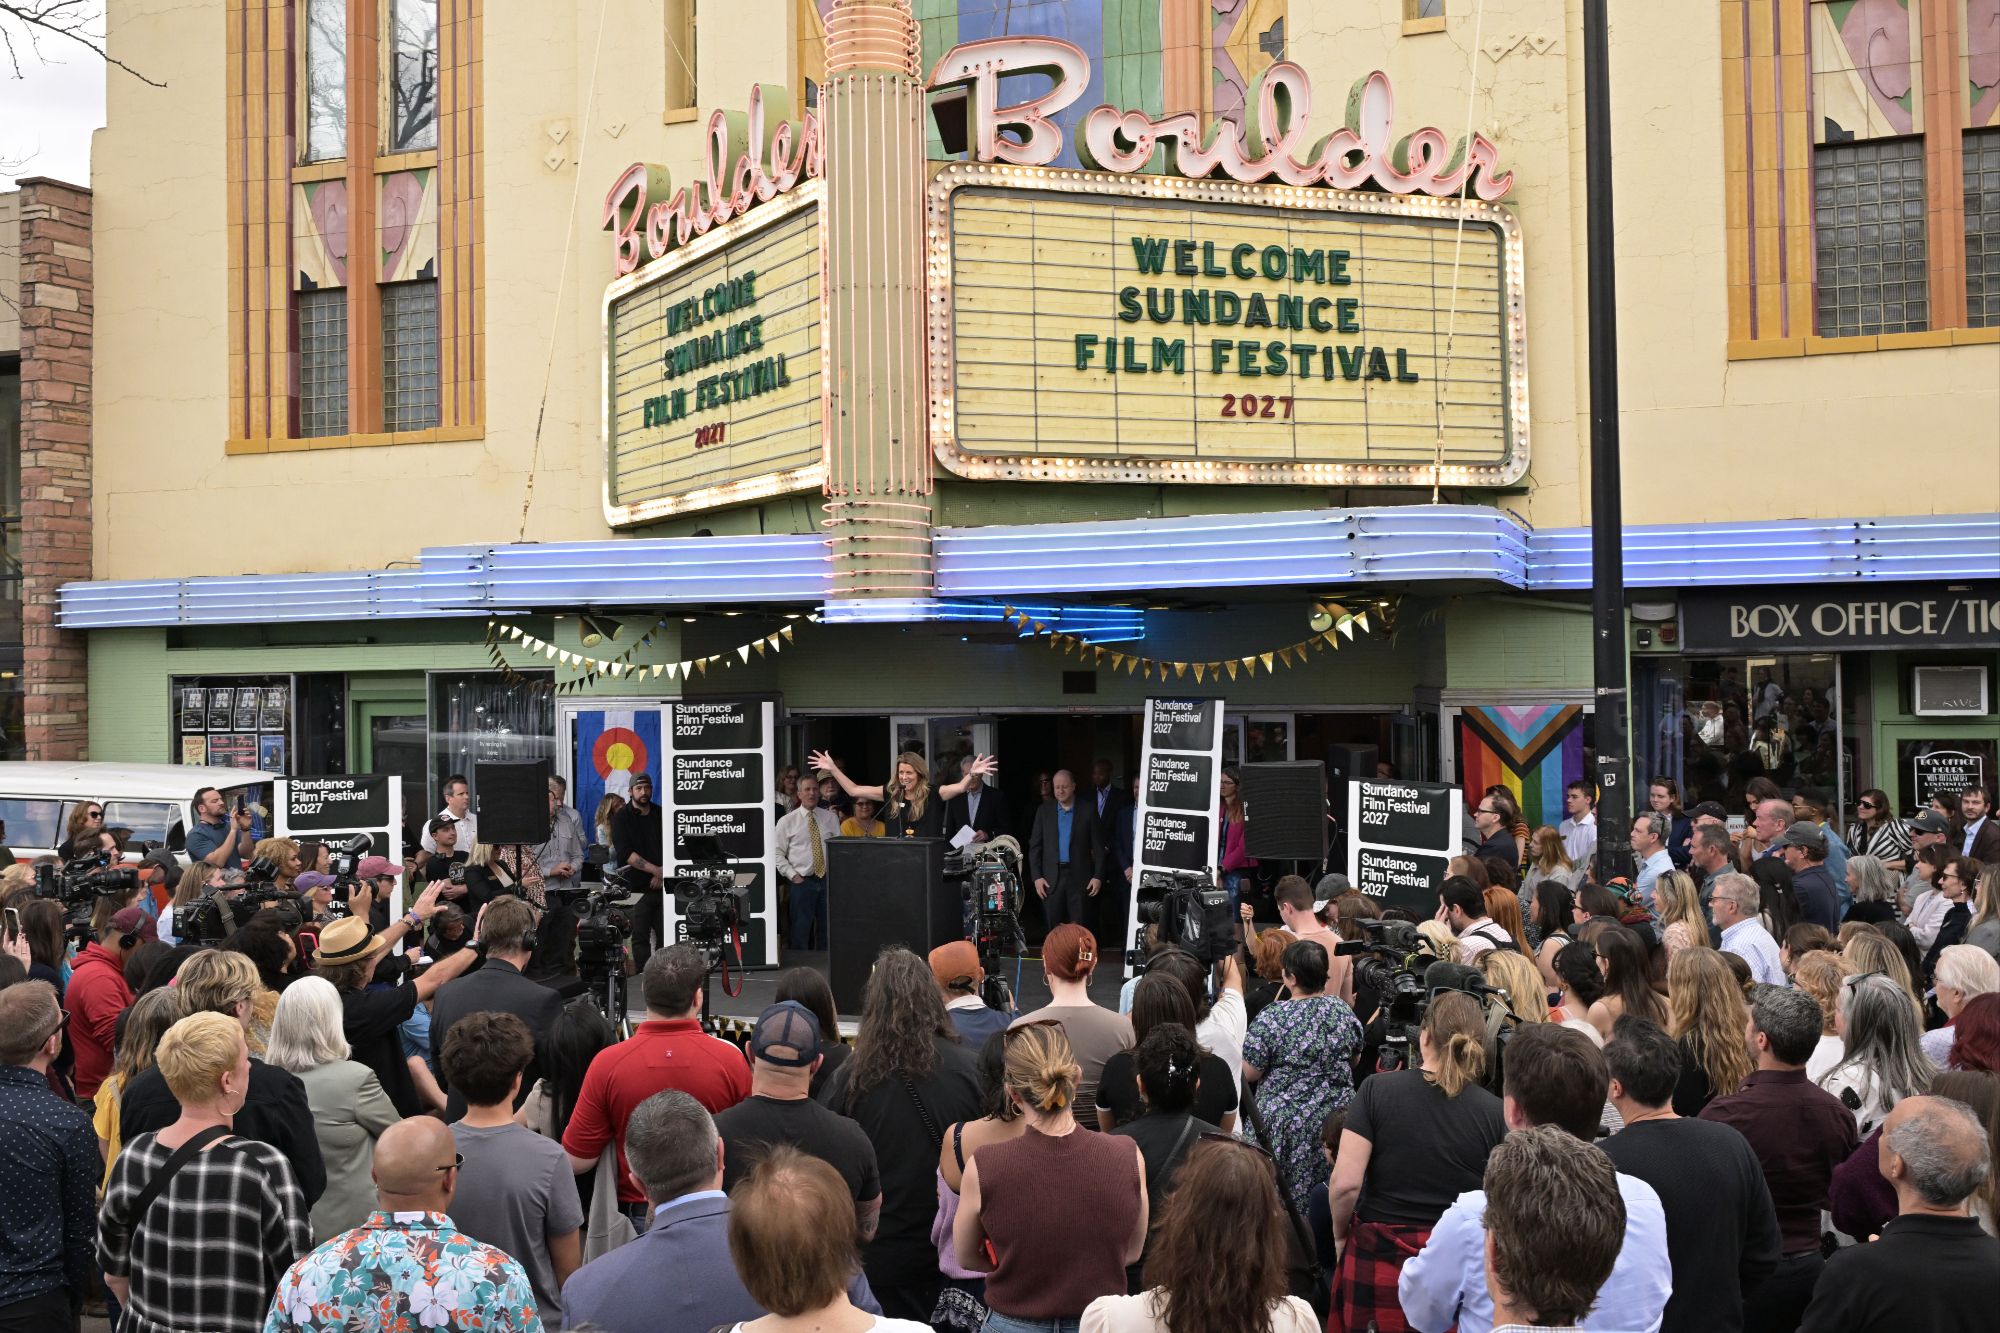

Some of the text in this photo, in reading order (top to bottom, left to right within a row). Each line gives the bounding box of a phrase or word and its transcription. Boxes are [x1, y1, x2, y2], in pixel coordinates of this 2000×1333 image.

[926, 35, 1514, 199] Boulder
[603, 83, 819, 278] Boulder
[1132, 236, 1351, 286] WELCOME
[666, 270, 757, 336] WELCOME
[1119, 287, 1359, 333] SUNDANCE
[664, 315, 764, 380] SUNDANCE
[1075, 335, 1419, 383] FILM FESTIVAL
[643, 353, 790, 428] FILM FESTIVAL
[1221, 393, 1295, 419] 2027
[694, 421, 726, 448] 2027
[1731, 604, 1801, 637] BOX
[676, 704, 731, 713] Sundance
[1155, 700, 1193, 710] Sundance
[676, 714, 743, 724] Film Festival
[1154, 711, 1201, 722] Film Festival
[676, 726, 704, 735] 2027
[1153, 723, 1172, 733] 2027
[677, 758, 732, 768] Sundance
[1152, 757, 1189, 769] Sundance
[677, 768, 744, 779] Film Festival
[1151, 769, 1198, 782] Film Festival
[291, 779, 354, 790] Sundance
[677, 781, 704, 790] 2027
[1150, 781, 1169, 791] 2027
[1363, 783, 1418, 799] Sundance
[291, 790, 368, 802] Film Festival
[291, 803, 322, 814] 2027
[1363, 797, 1430, 815] Film Festival
[677, 813, 733, 823] Sundance
[1148, 816, 1186, 829] Sundance
[1363, 811, 1389, 825] 2027
[678, 823, 745, 834] Film Festival
[1147, 827, 1194, 842] Film Festival
[1145, 839, 1166, 851] 2027
[1362, 853, 1417, 871] Sundance
[1362, 868, 1429, 888] Film Festival
[1361, 882, 1388, 897] 2027
